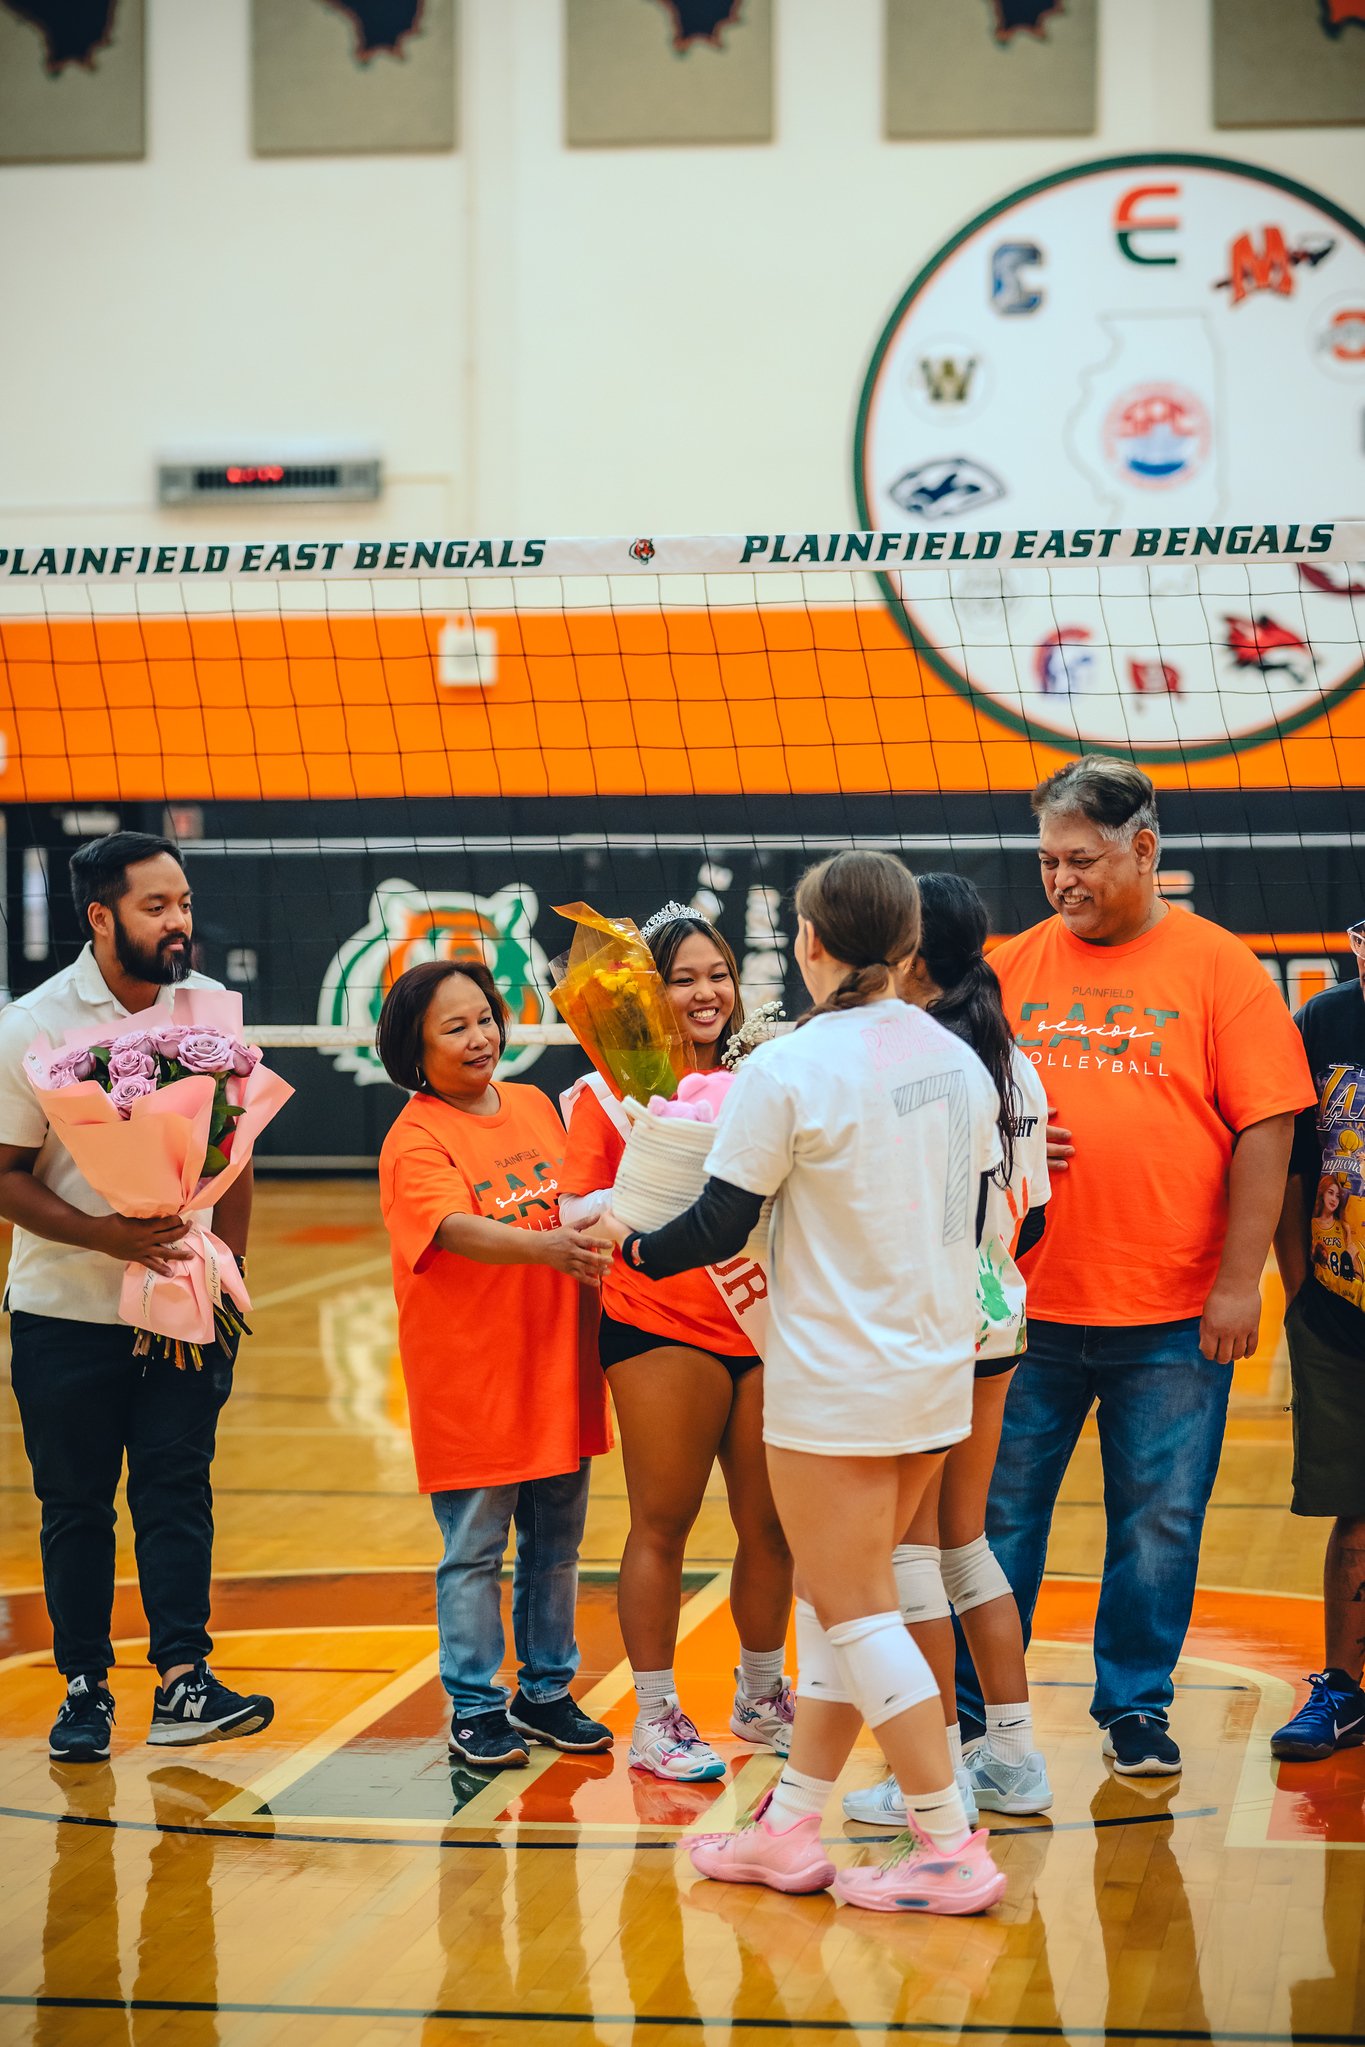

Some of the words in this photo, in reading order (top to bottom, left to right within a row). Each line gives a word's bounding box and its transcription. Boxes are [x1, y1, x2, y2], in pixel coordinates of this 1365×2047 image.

[239, 543, 343, 571] EAST
[353, 539, 546, 569] BENGALS
[739, 532, 1001, 563] PLAINFIELD
[1010, 529, 1122, 558] EAST
[1130, 523, 1335, 557] BENGALS
[1072, 986, 1134, 999] PLAINFIELD
[1037, 1020, 1154, 1038] senior
[1029, 1051, 1170, 1077] OLLEYBALL
[890, 1068, 970, 1246] 7
